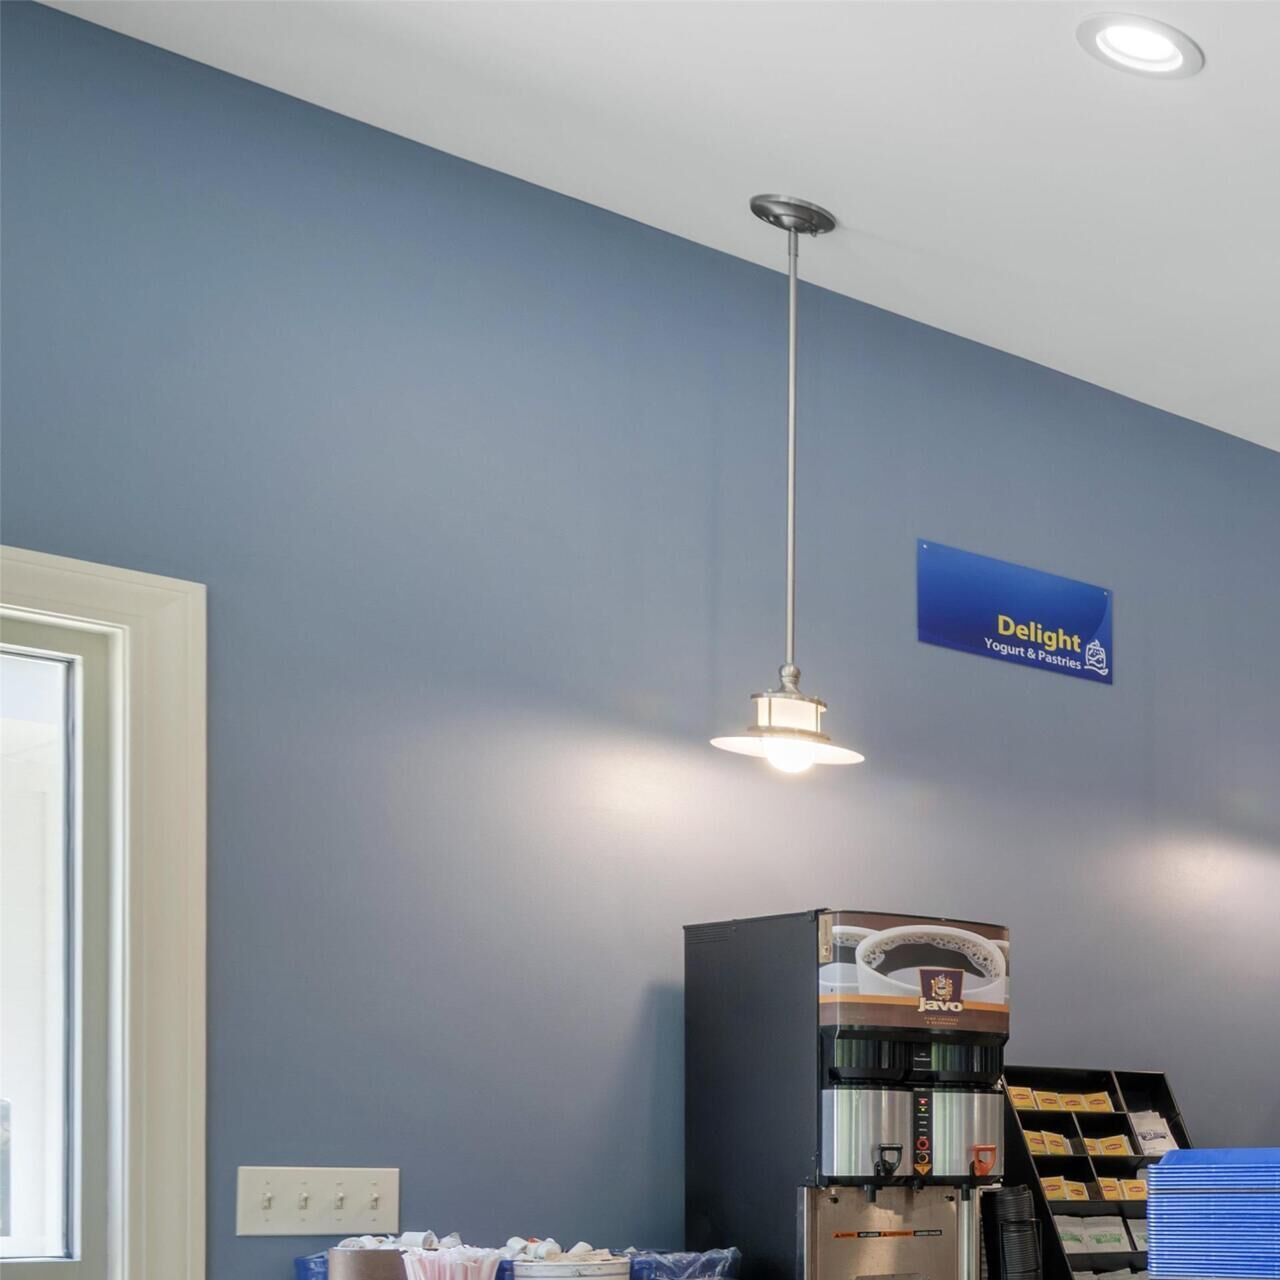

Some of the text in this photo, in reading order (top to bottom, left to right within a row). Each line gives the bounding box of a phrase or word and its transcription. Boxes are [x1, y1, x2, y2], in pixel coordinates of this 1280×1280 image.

[997, 614, 1082, 653] Delight
[984, 637, 1082, 670] Yogurt & Pastries
